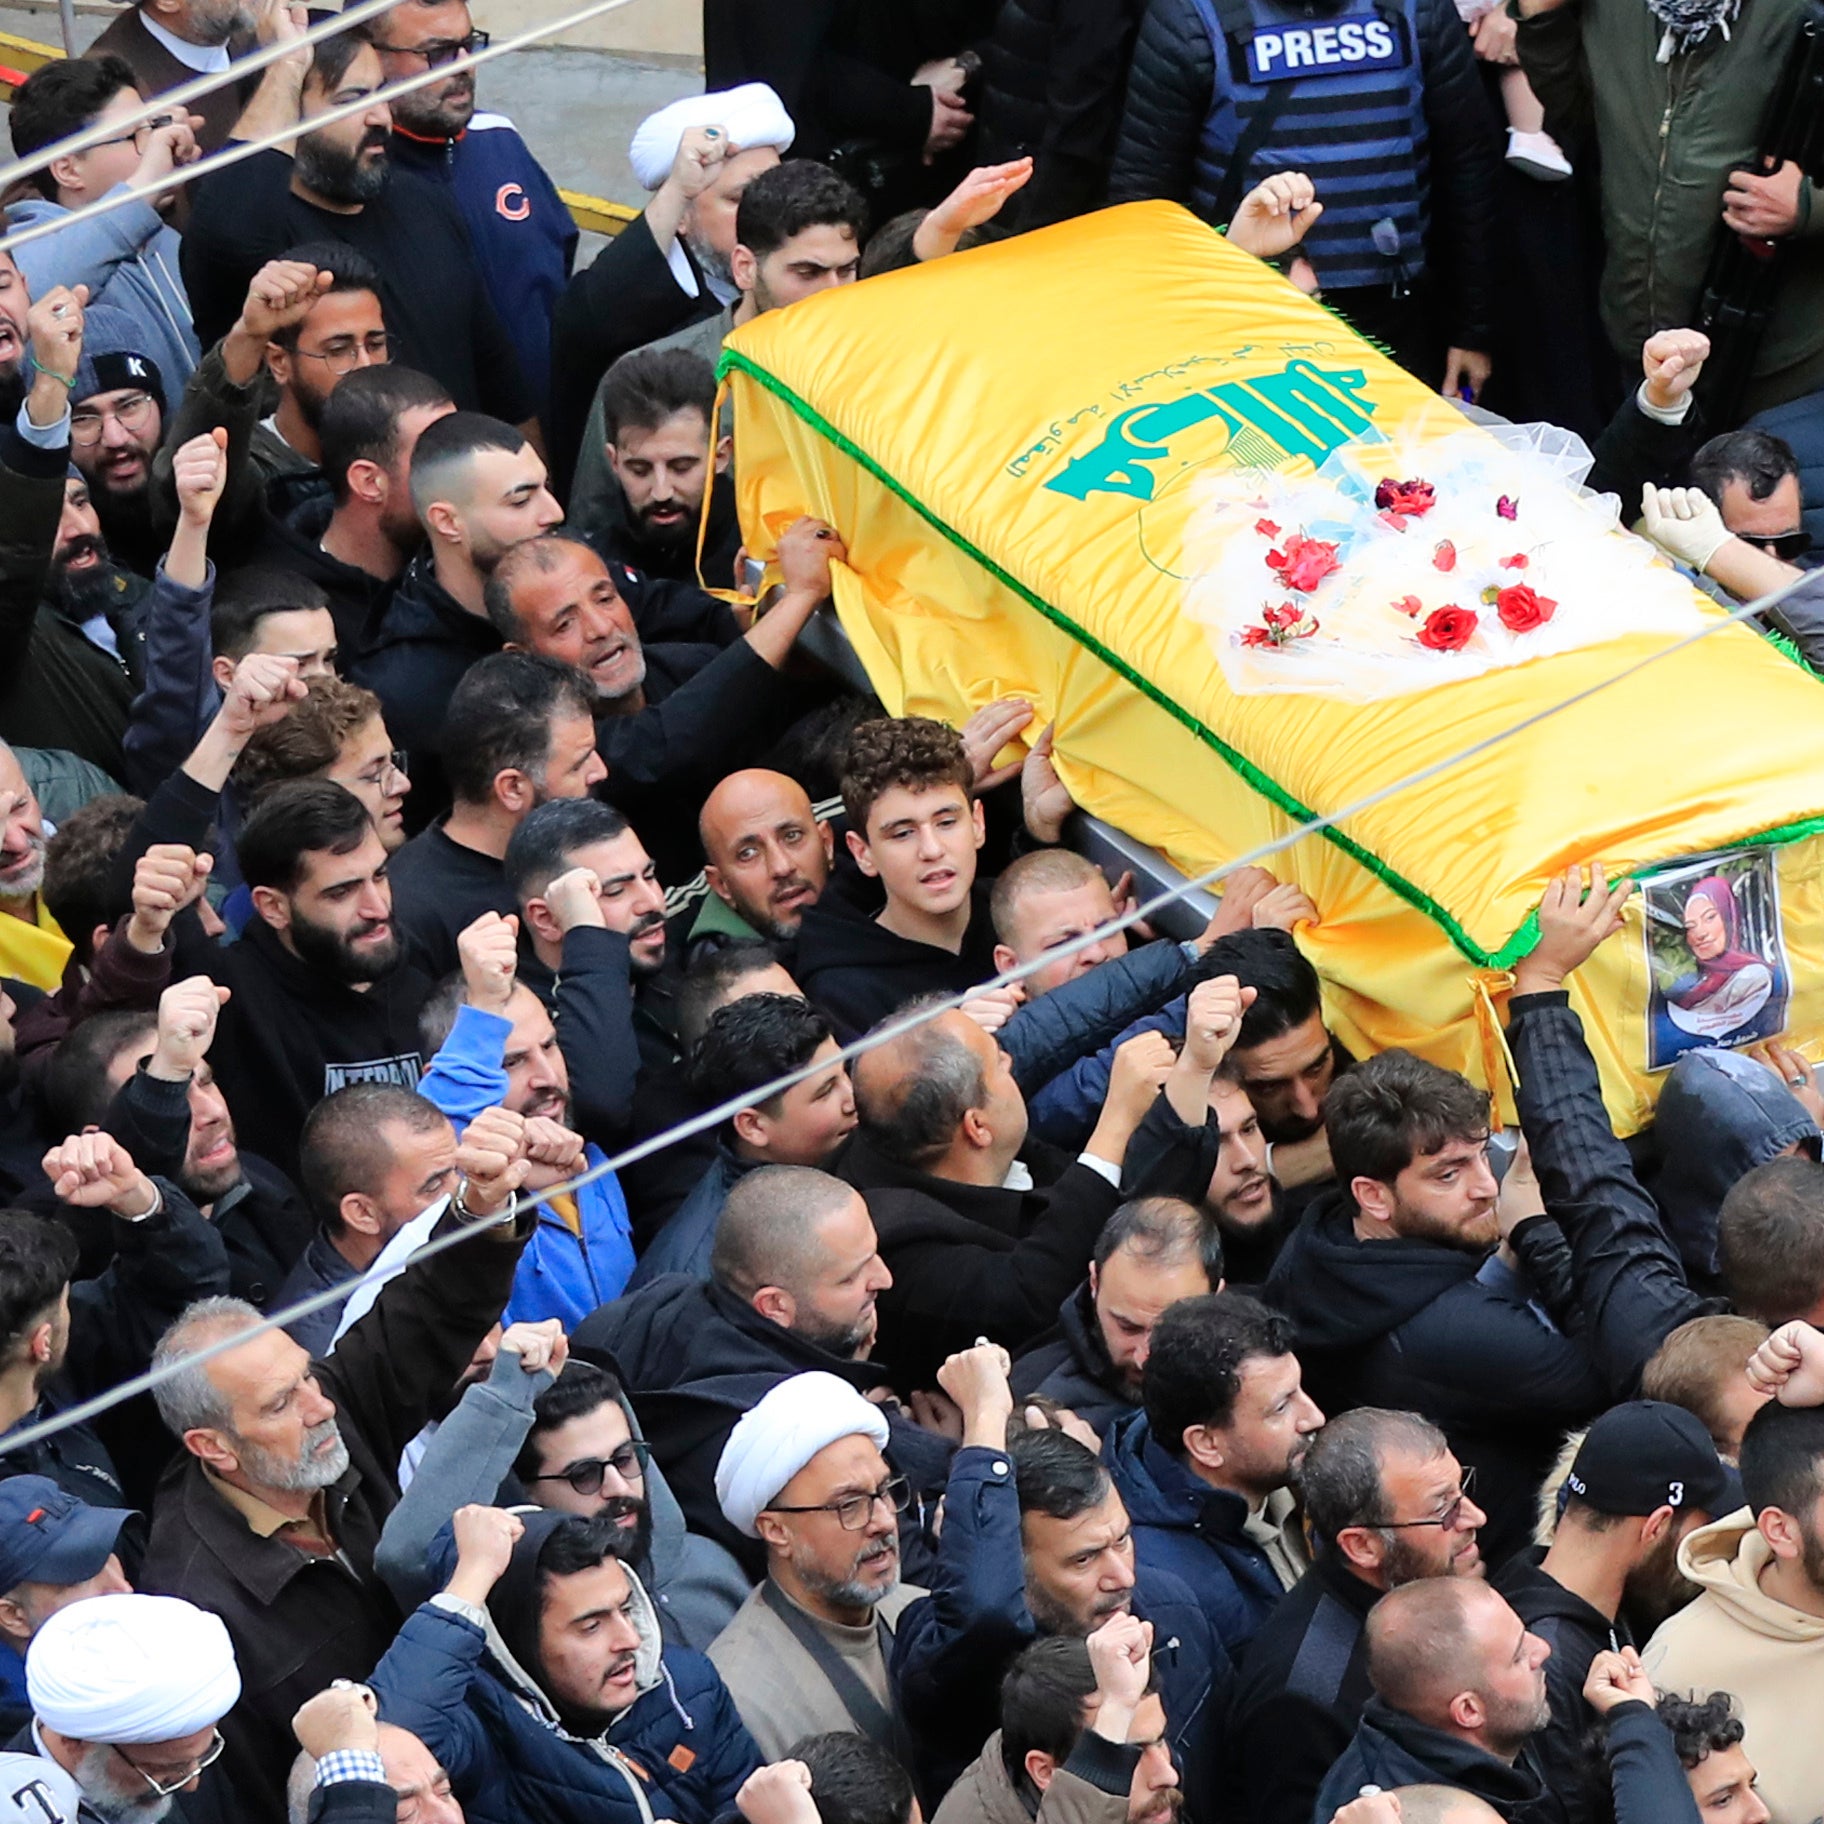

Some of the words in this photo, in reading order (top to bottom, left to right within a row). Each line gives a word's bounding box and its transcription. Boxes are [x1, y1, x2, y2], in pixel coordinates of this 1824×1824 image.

[1254, 20, 1394, 72] PRESS
[495, 182, 530, 221] C
[127, 356, 147, 377] K
[1667, 1481, 1684, 1506] 3
